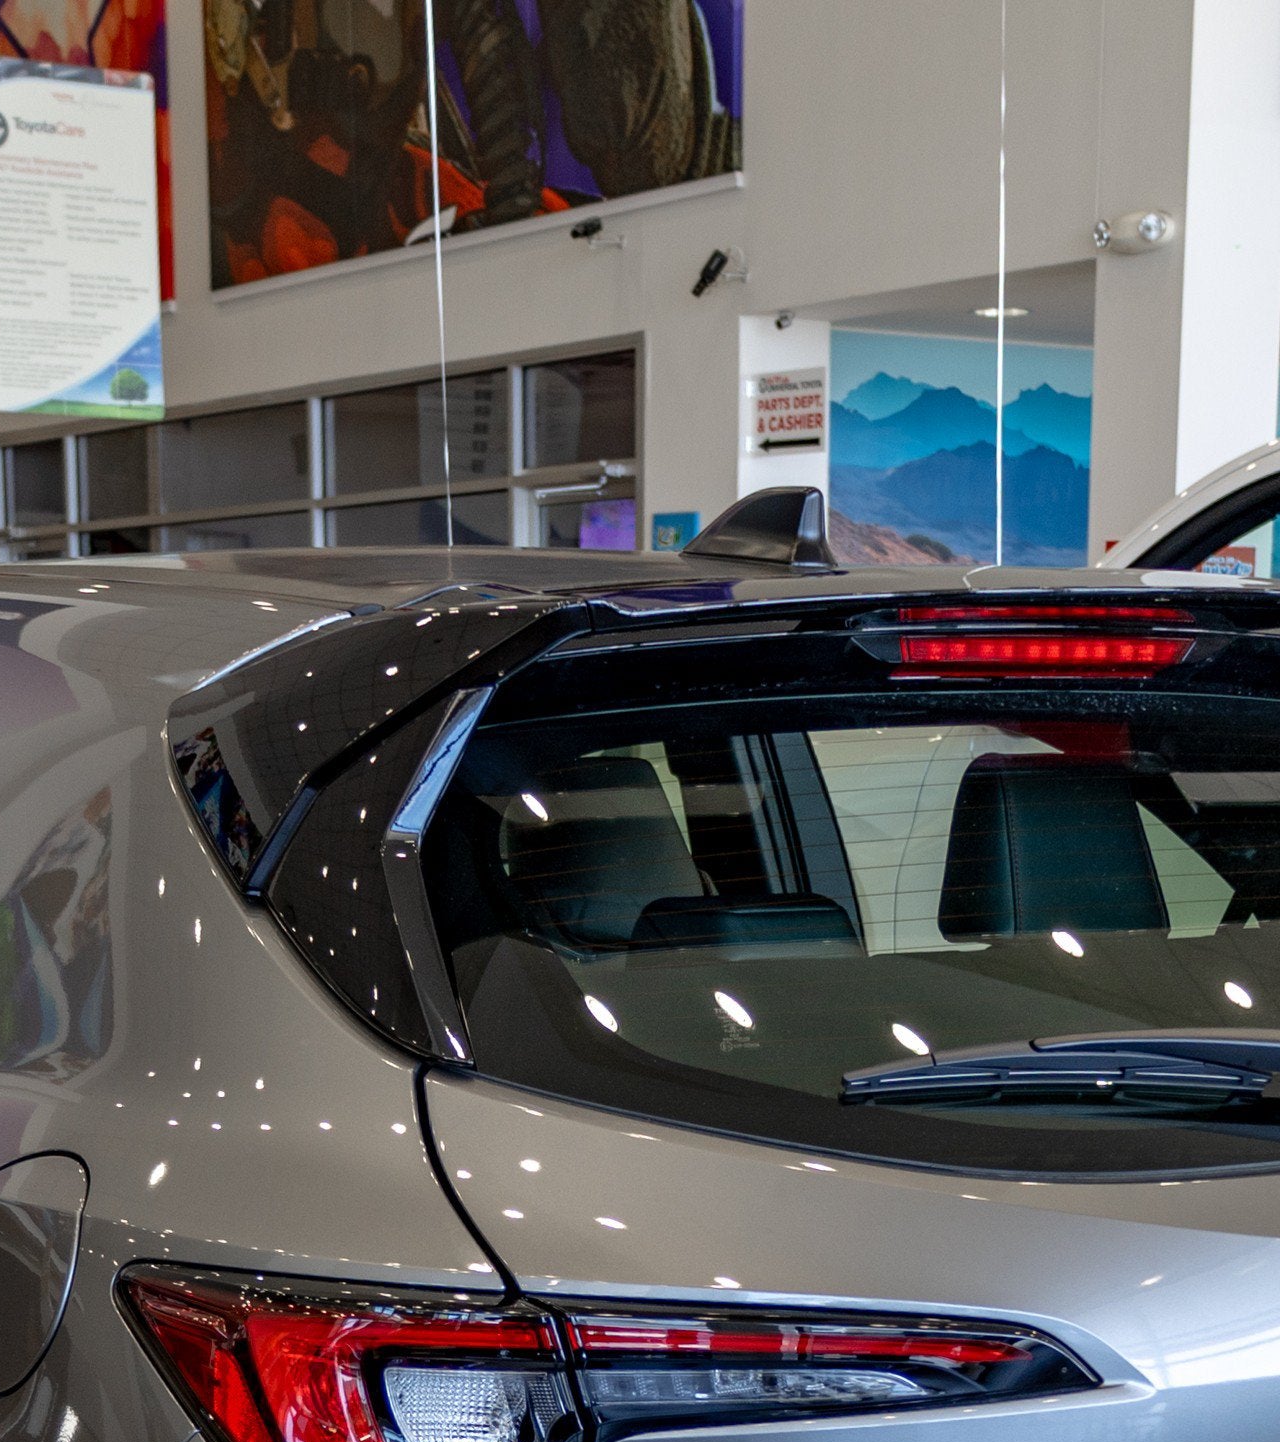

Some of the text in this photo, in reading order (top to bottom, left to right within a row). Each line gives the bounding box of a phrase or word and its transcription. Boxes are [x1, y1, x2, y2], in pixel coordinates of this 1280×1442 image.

[12, 116, 86, 138] ToyotaCare
[757, 394, 823, 412] PARTS DEPT.
[769, 412, 823, 432] CASHIER
